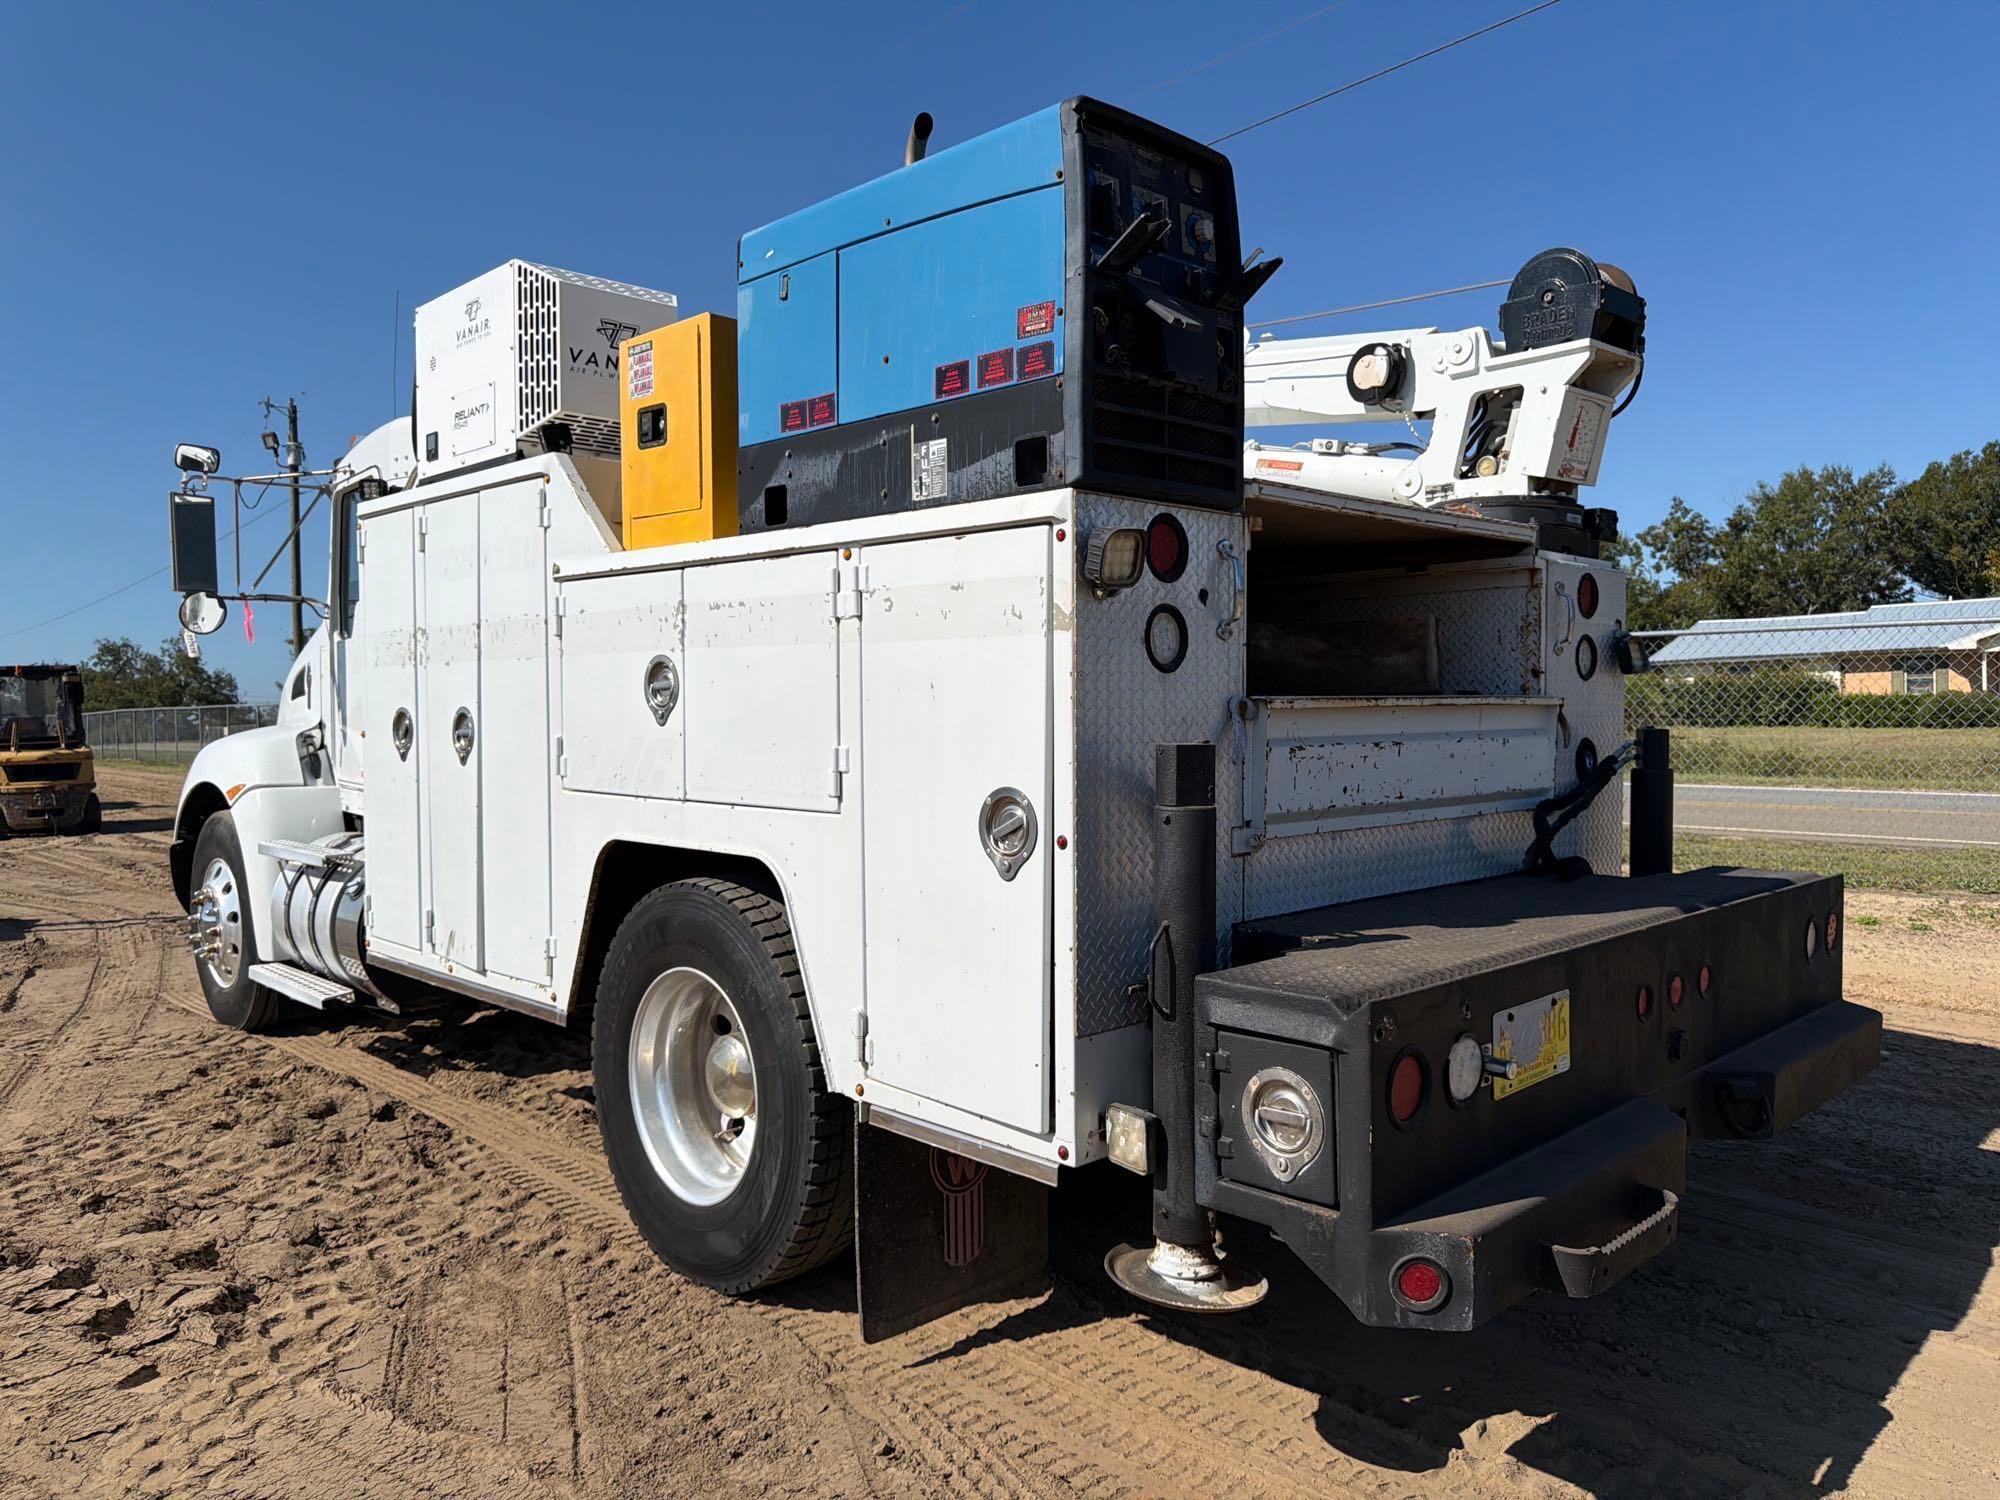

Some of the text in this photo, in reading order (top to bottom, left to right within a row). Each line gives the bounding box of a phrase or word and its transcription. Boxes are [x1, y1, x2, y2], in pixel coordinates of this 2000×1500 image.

[1521, 304, 1576, 330] BRADEN
[456, 318, 489, 342] VANAIR
[569, 347, 619, 371] VAN
[454, 403, 486, 422] RELIANT
[921, 445, 930, 496] FUEL
